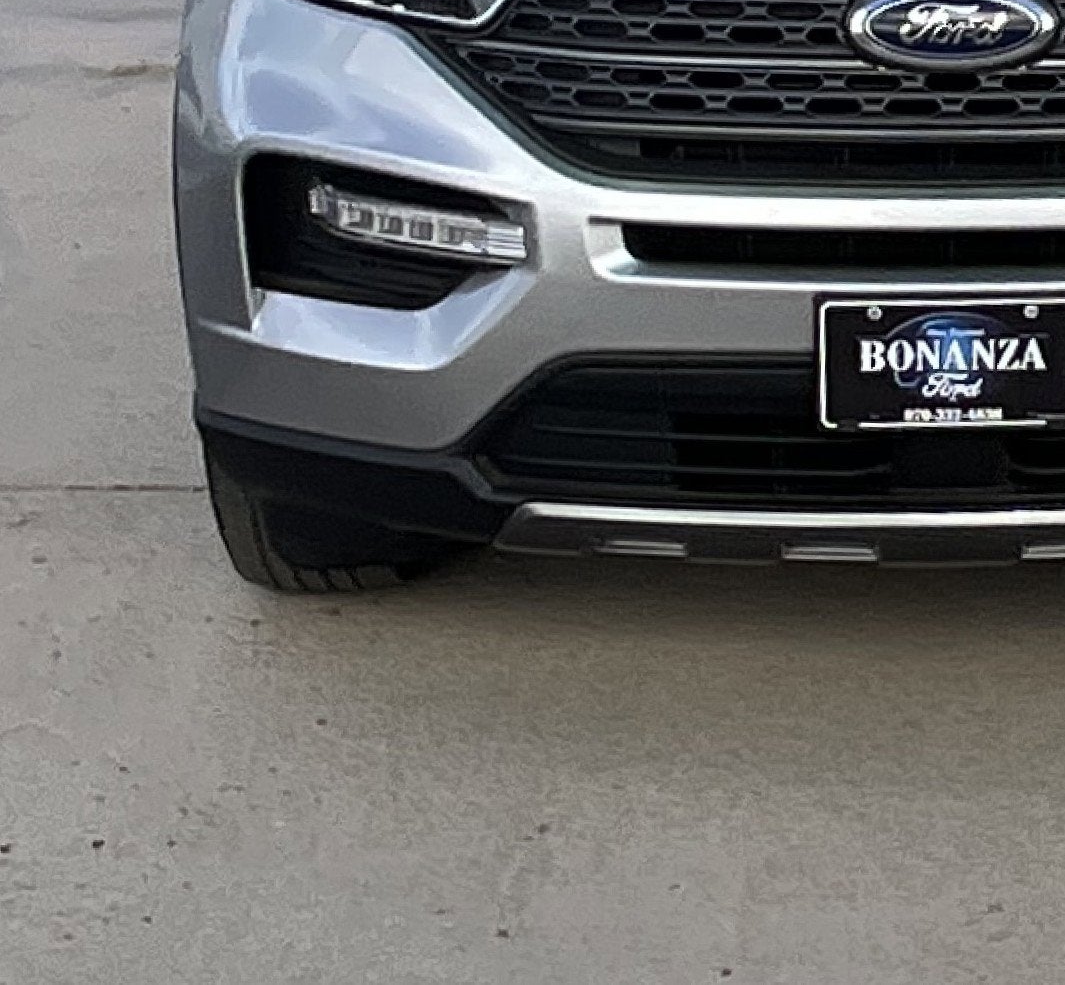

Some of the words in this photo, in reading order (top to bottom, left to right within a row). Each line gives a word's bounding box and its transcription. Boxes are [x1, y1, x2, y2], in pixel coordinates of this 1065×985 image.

[899, 2, 1008, 46] Ford
[859, 337, 1048, 372] BONANZA
[922, 372, 984, 402] Ford
